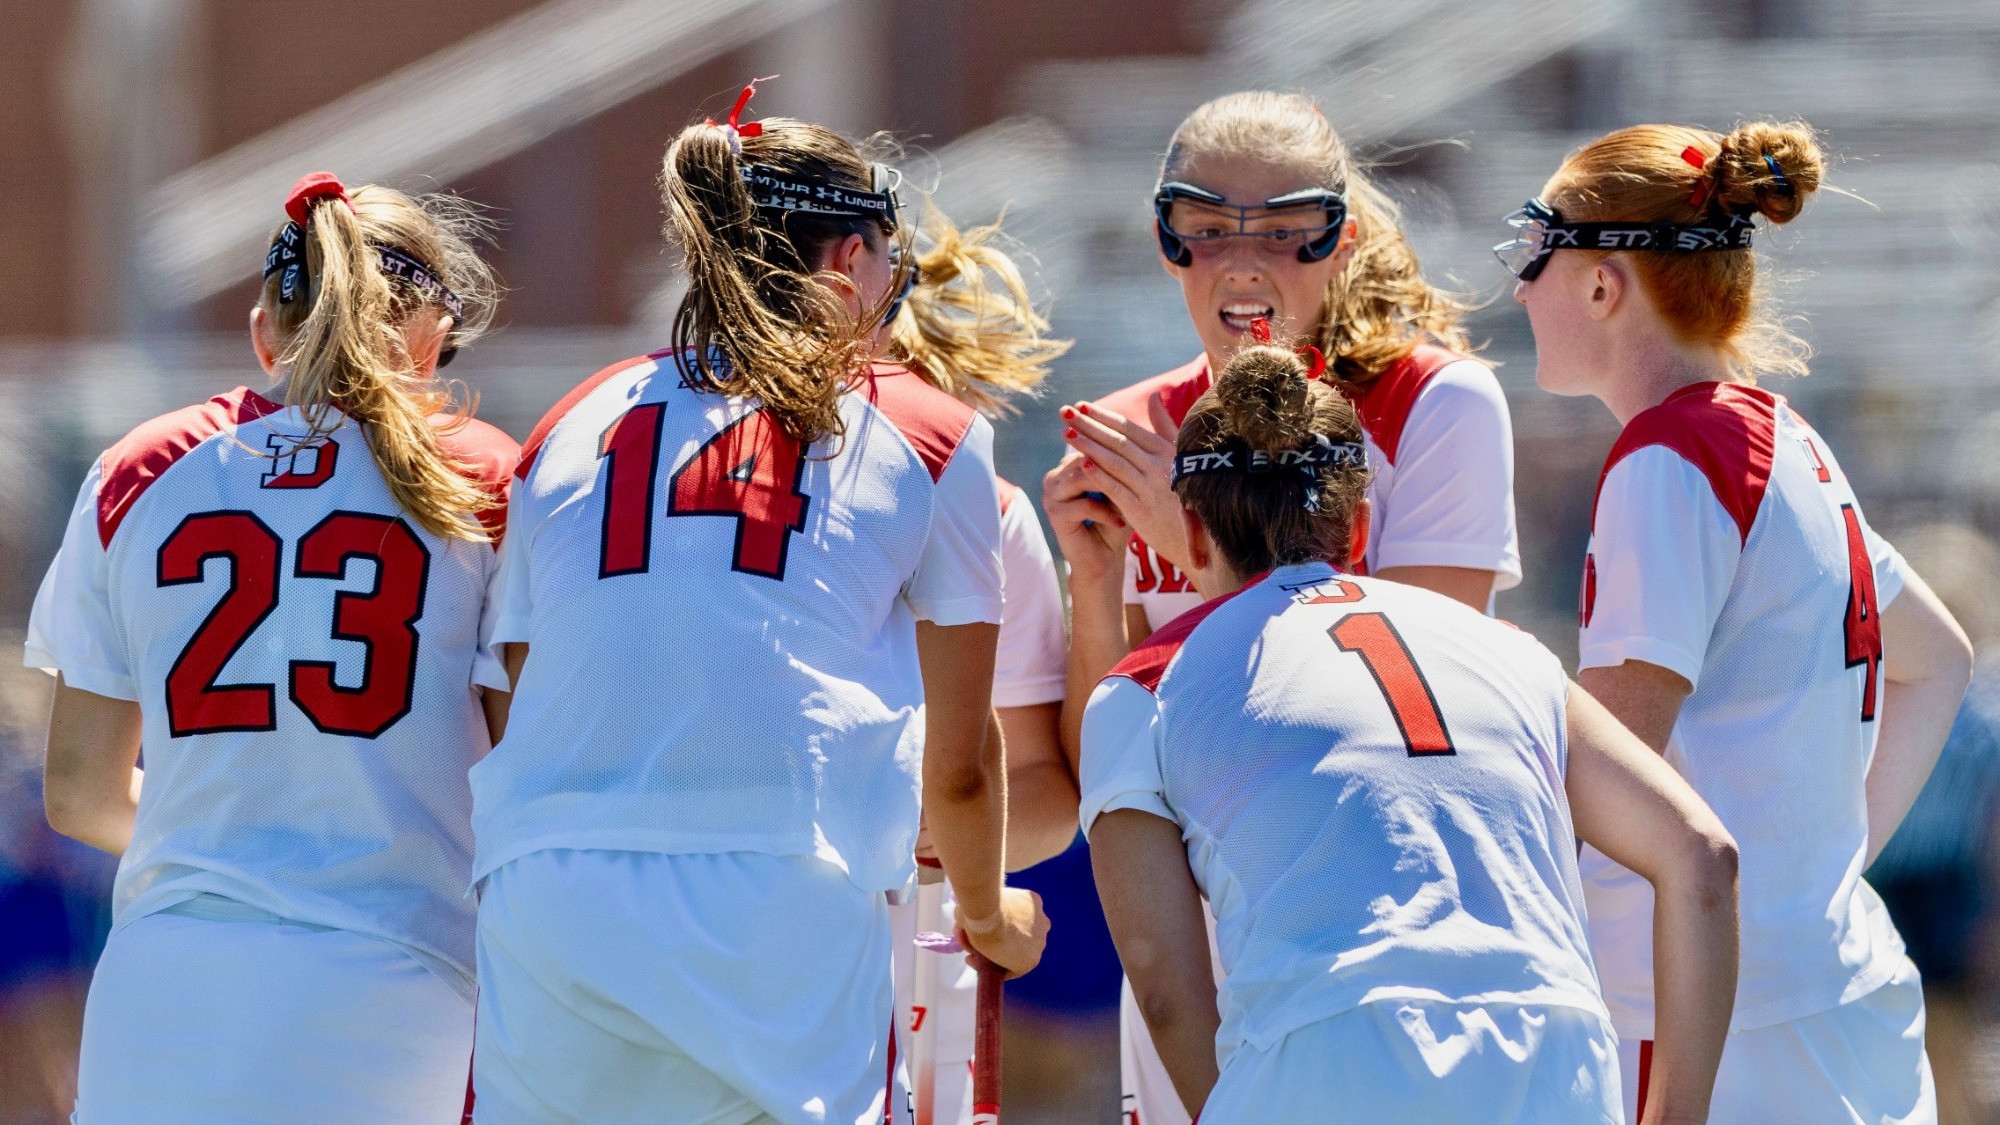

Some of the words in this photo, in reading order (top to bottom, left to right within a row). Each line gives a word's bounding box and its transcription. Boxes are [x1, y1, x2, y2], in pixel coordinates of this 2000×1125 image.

[596, 401, 811, 582] 14
[1182, 451, 1234, 474] STX
[157, 509, 431, 740] 23
[1326, 612, 1457, 758] 1
[1840, 502, 1883, 722] 4
